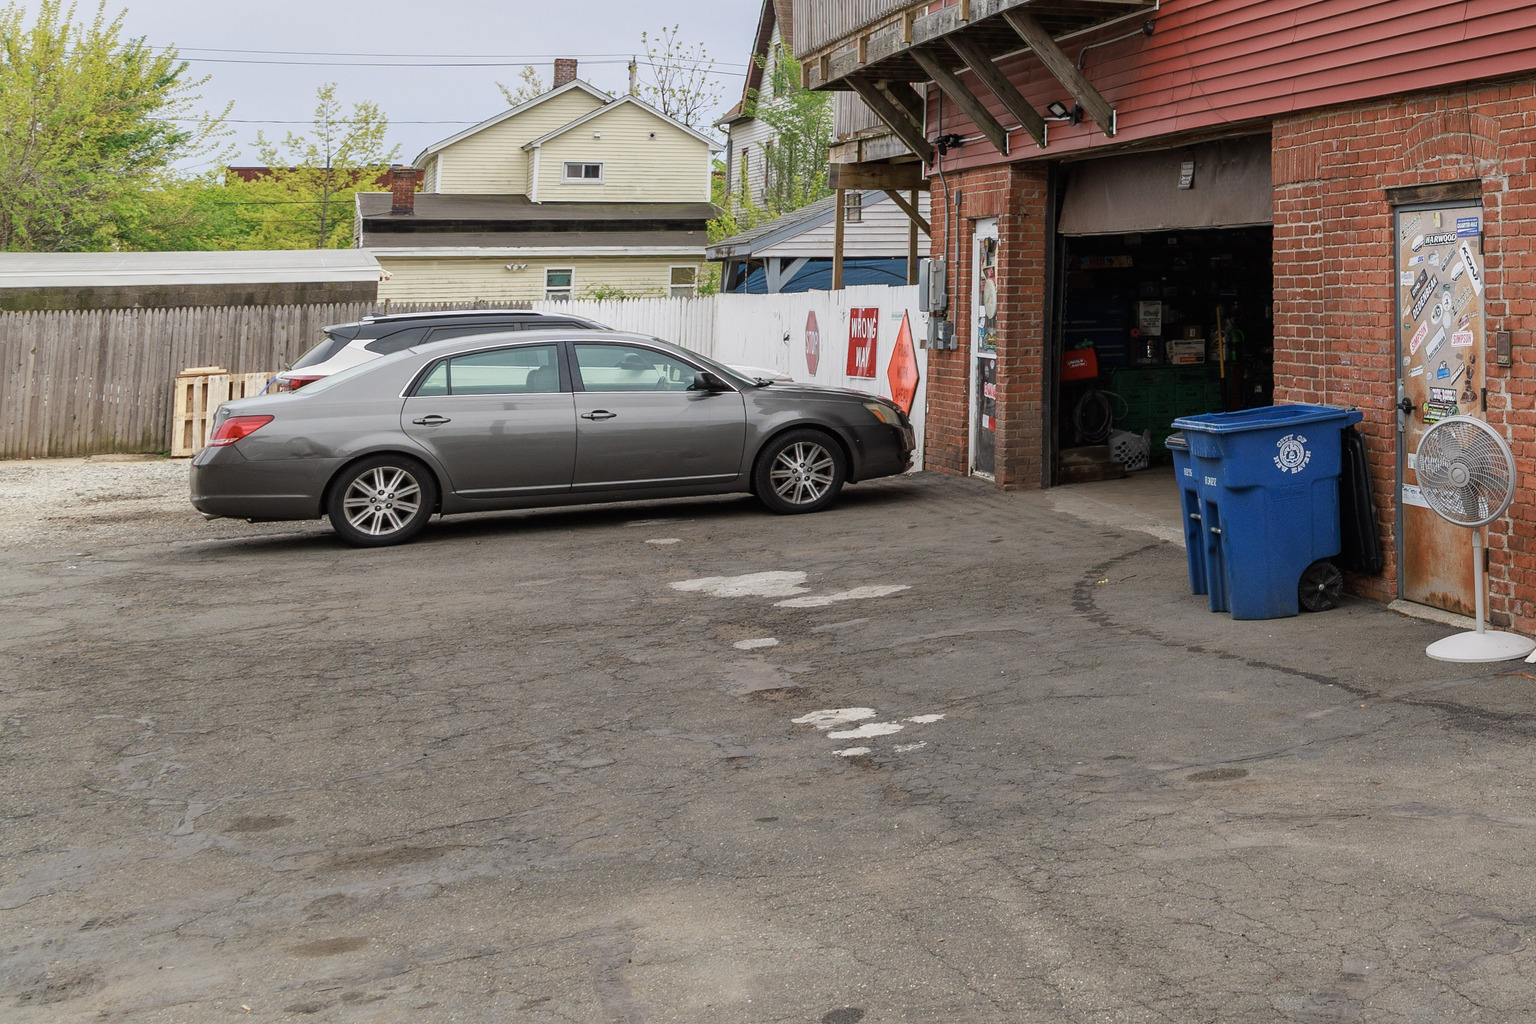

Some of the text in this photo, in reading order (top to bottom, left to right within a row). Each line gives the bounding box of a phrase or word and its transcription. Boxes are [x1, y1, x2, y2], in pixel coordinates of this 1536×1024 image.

[1425, 233, 1457, 245] HARWOOD
[1462, 247, 1478, 281] KONI
[851, 317, 877, 339] WRONG
[805, 330, 819, 355] STOP
[855, 346, 871, 368] WAY
[1276, 433, 1307, 448] CITY OF
